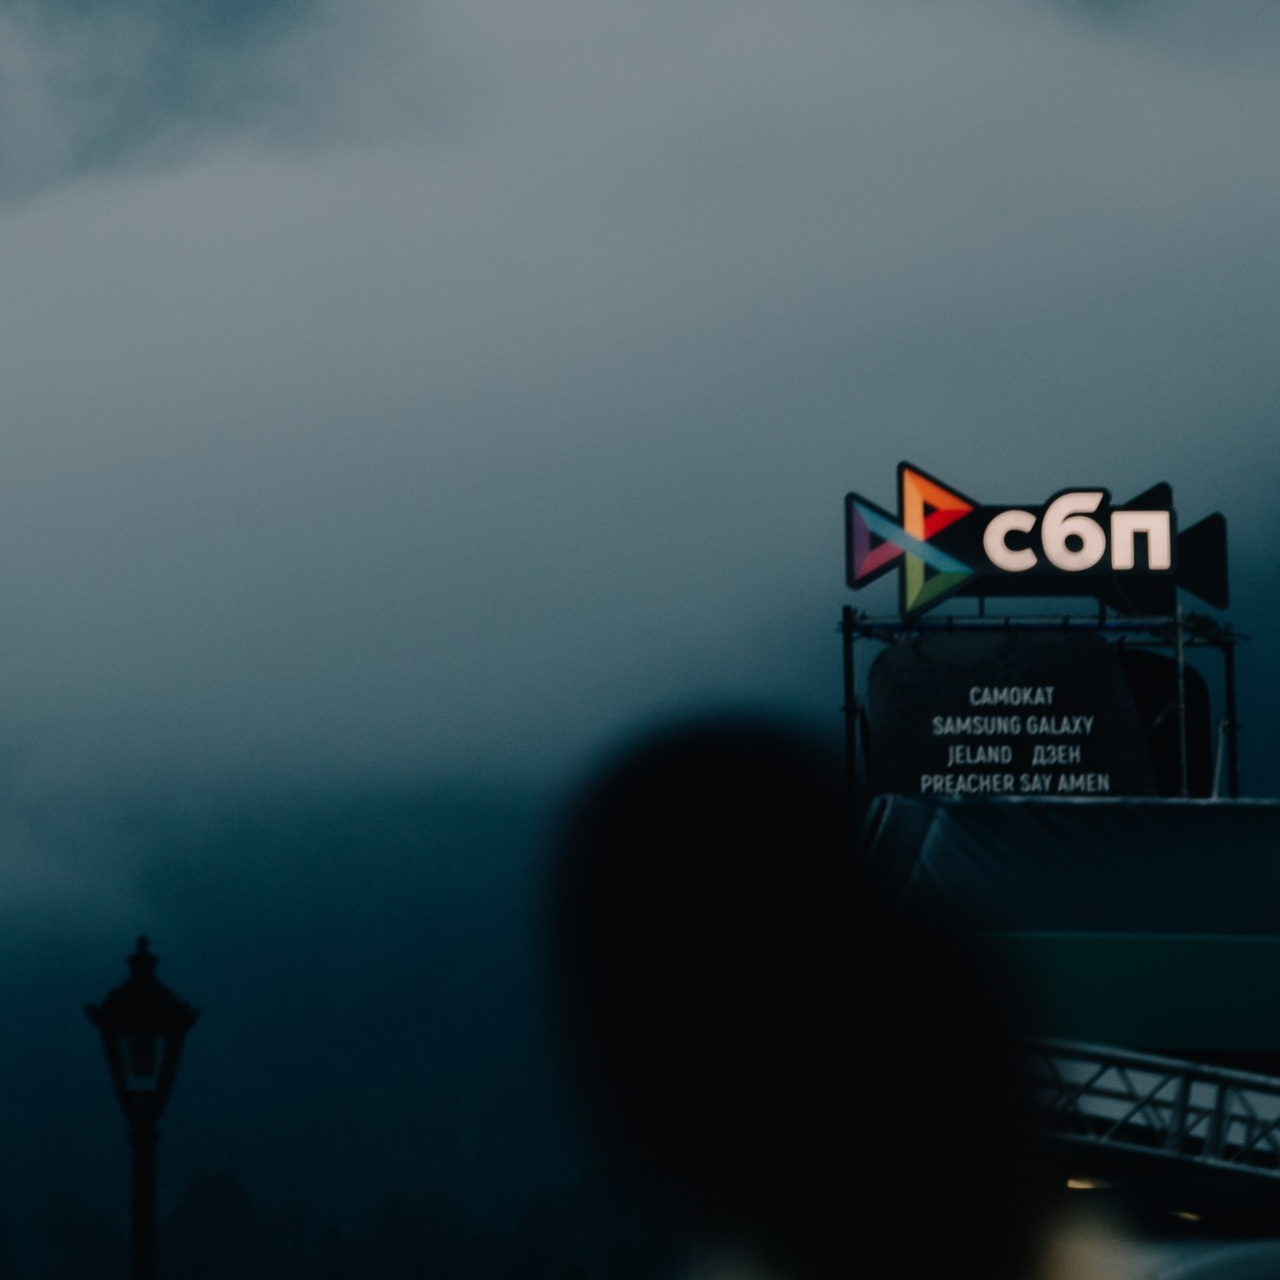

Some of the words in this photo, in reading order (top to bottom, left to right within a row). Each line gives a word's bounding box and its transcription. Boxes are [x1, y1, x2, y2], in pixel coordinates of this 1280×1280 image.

[982, 491, 1172, 572] сбп
[969, 686, 1056, 706] САМОКАТ
[932, 715, 1021, 736] SAMSUNG
[1026, 715, 1095, 736] GALAXY
[946, 744, 1013, 768] JELAND
[1031, 744, 1082, 767] ДЗЕН
[920, 773, 1015, 793] PREACHER
[1019, 773, 1052, 793] SAY
[1057, 773, 1110, 792] AMEN
